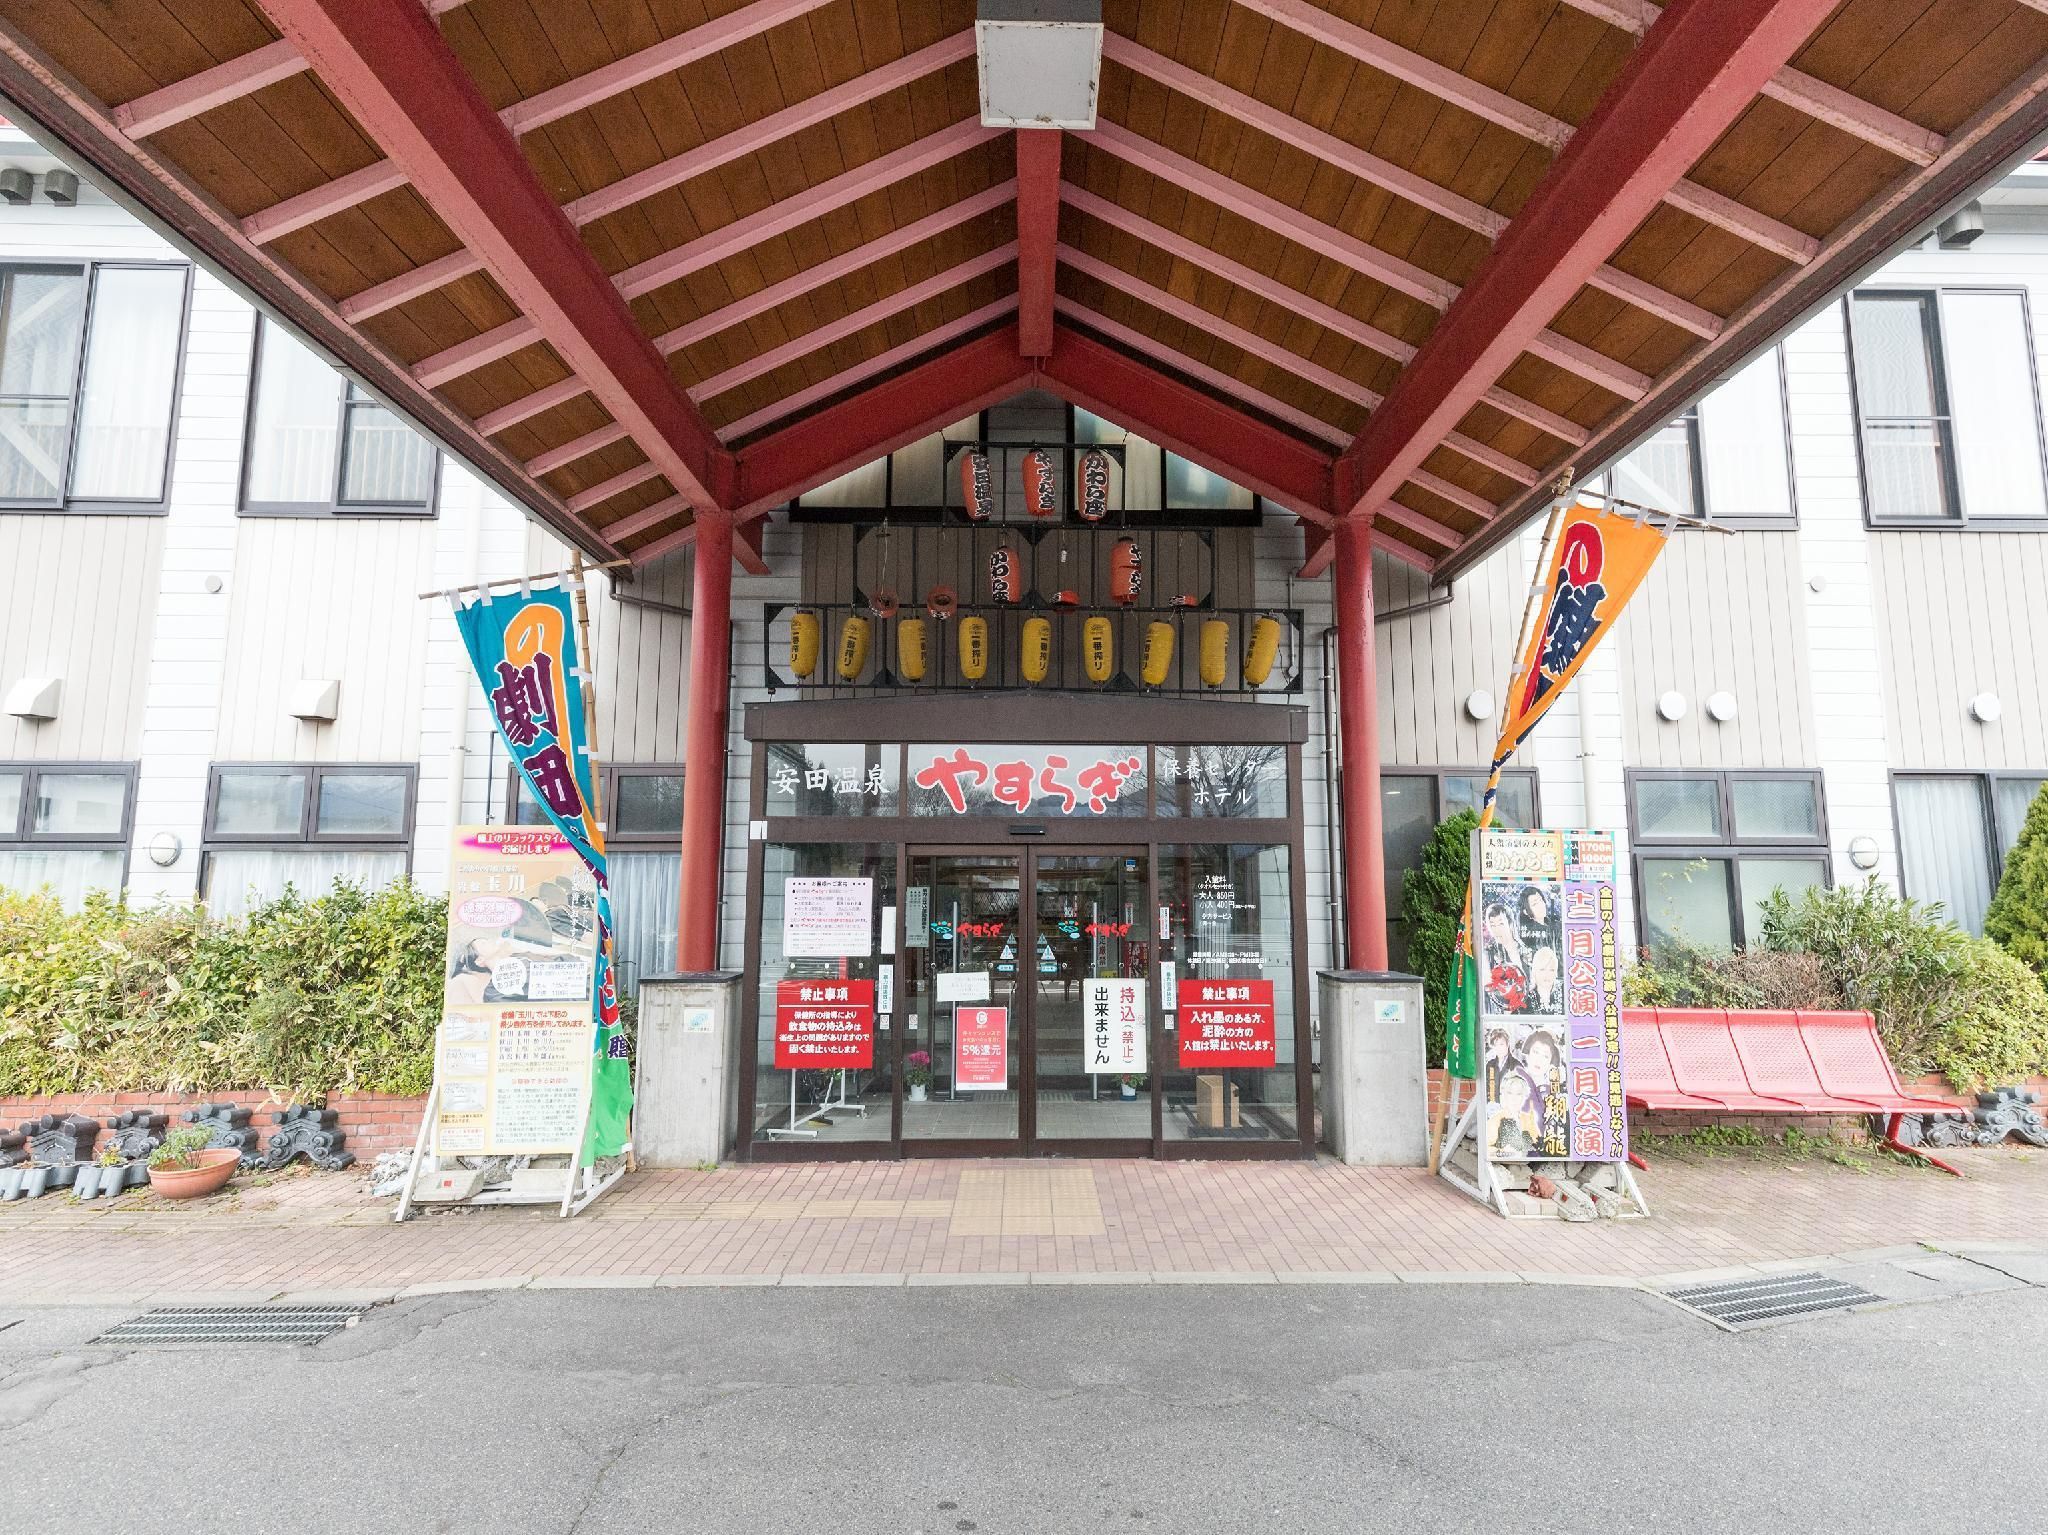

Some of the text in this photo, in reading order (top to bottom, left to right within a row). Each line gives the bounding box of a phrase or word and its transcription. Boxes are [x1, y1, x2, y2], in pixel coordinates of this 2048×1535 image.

[1084, 454, 1108, 517] かわら座
[971, 635, 981, 667] 一番搾り
[1093, 636, 1104, 670] 一番搾り
[1162, 757, 1280, 778] 保養センター
[770, 764, 890, 796] 安田温泉
[915, 748, 1142, 815] やすらぎ
[1193, 787, 1251, 806] ホテル
[502, 845, 551, 854] お届けします
[1199, 891, 1213, 899] 大人
[800, 987, 848, 1001] 禁止事項
[1202, 987, 1250, 1000] 禁止事項
[794, 1011, 857, 1019] 保健所の指導により
[1190, 1011, 1266, 1023] 入れ墨のある方、
[788, 1021, 861, 1031] 飲食物の持込みは
[1094, 986, 1110, 1065] 出来ません
[1202, 1025, 1254, 1037] 泥酔の方の
[779, 1033, 870, 1042] 衛生上の問題がありますので
[788, 1044, 860, 1054] 固く禁止いたします。
[962, 1045, 1001, 1056] 5%還元
[1183, 1039, 1274, 1051] 入館は禁止いたします。
[1572, 1036, 1604, 1156] 一月公演
